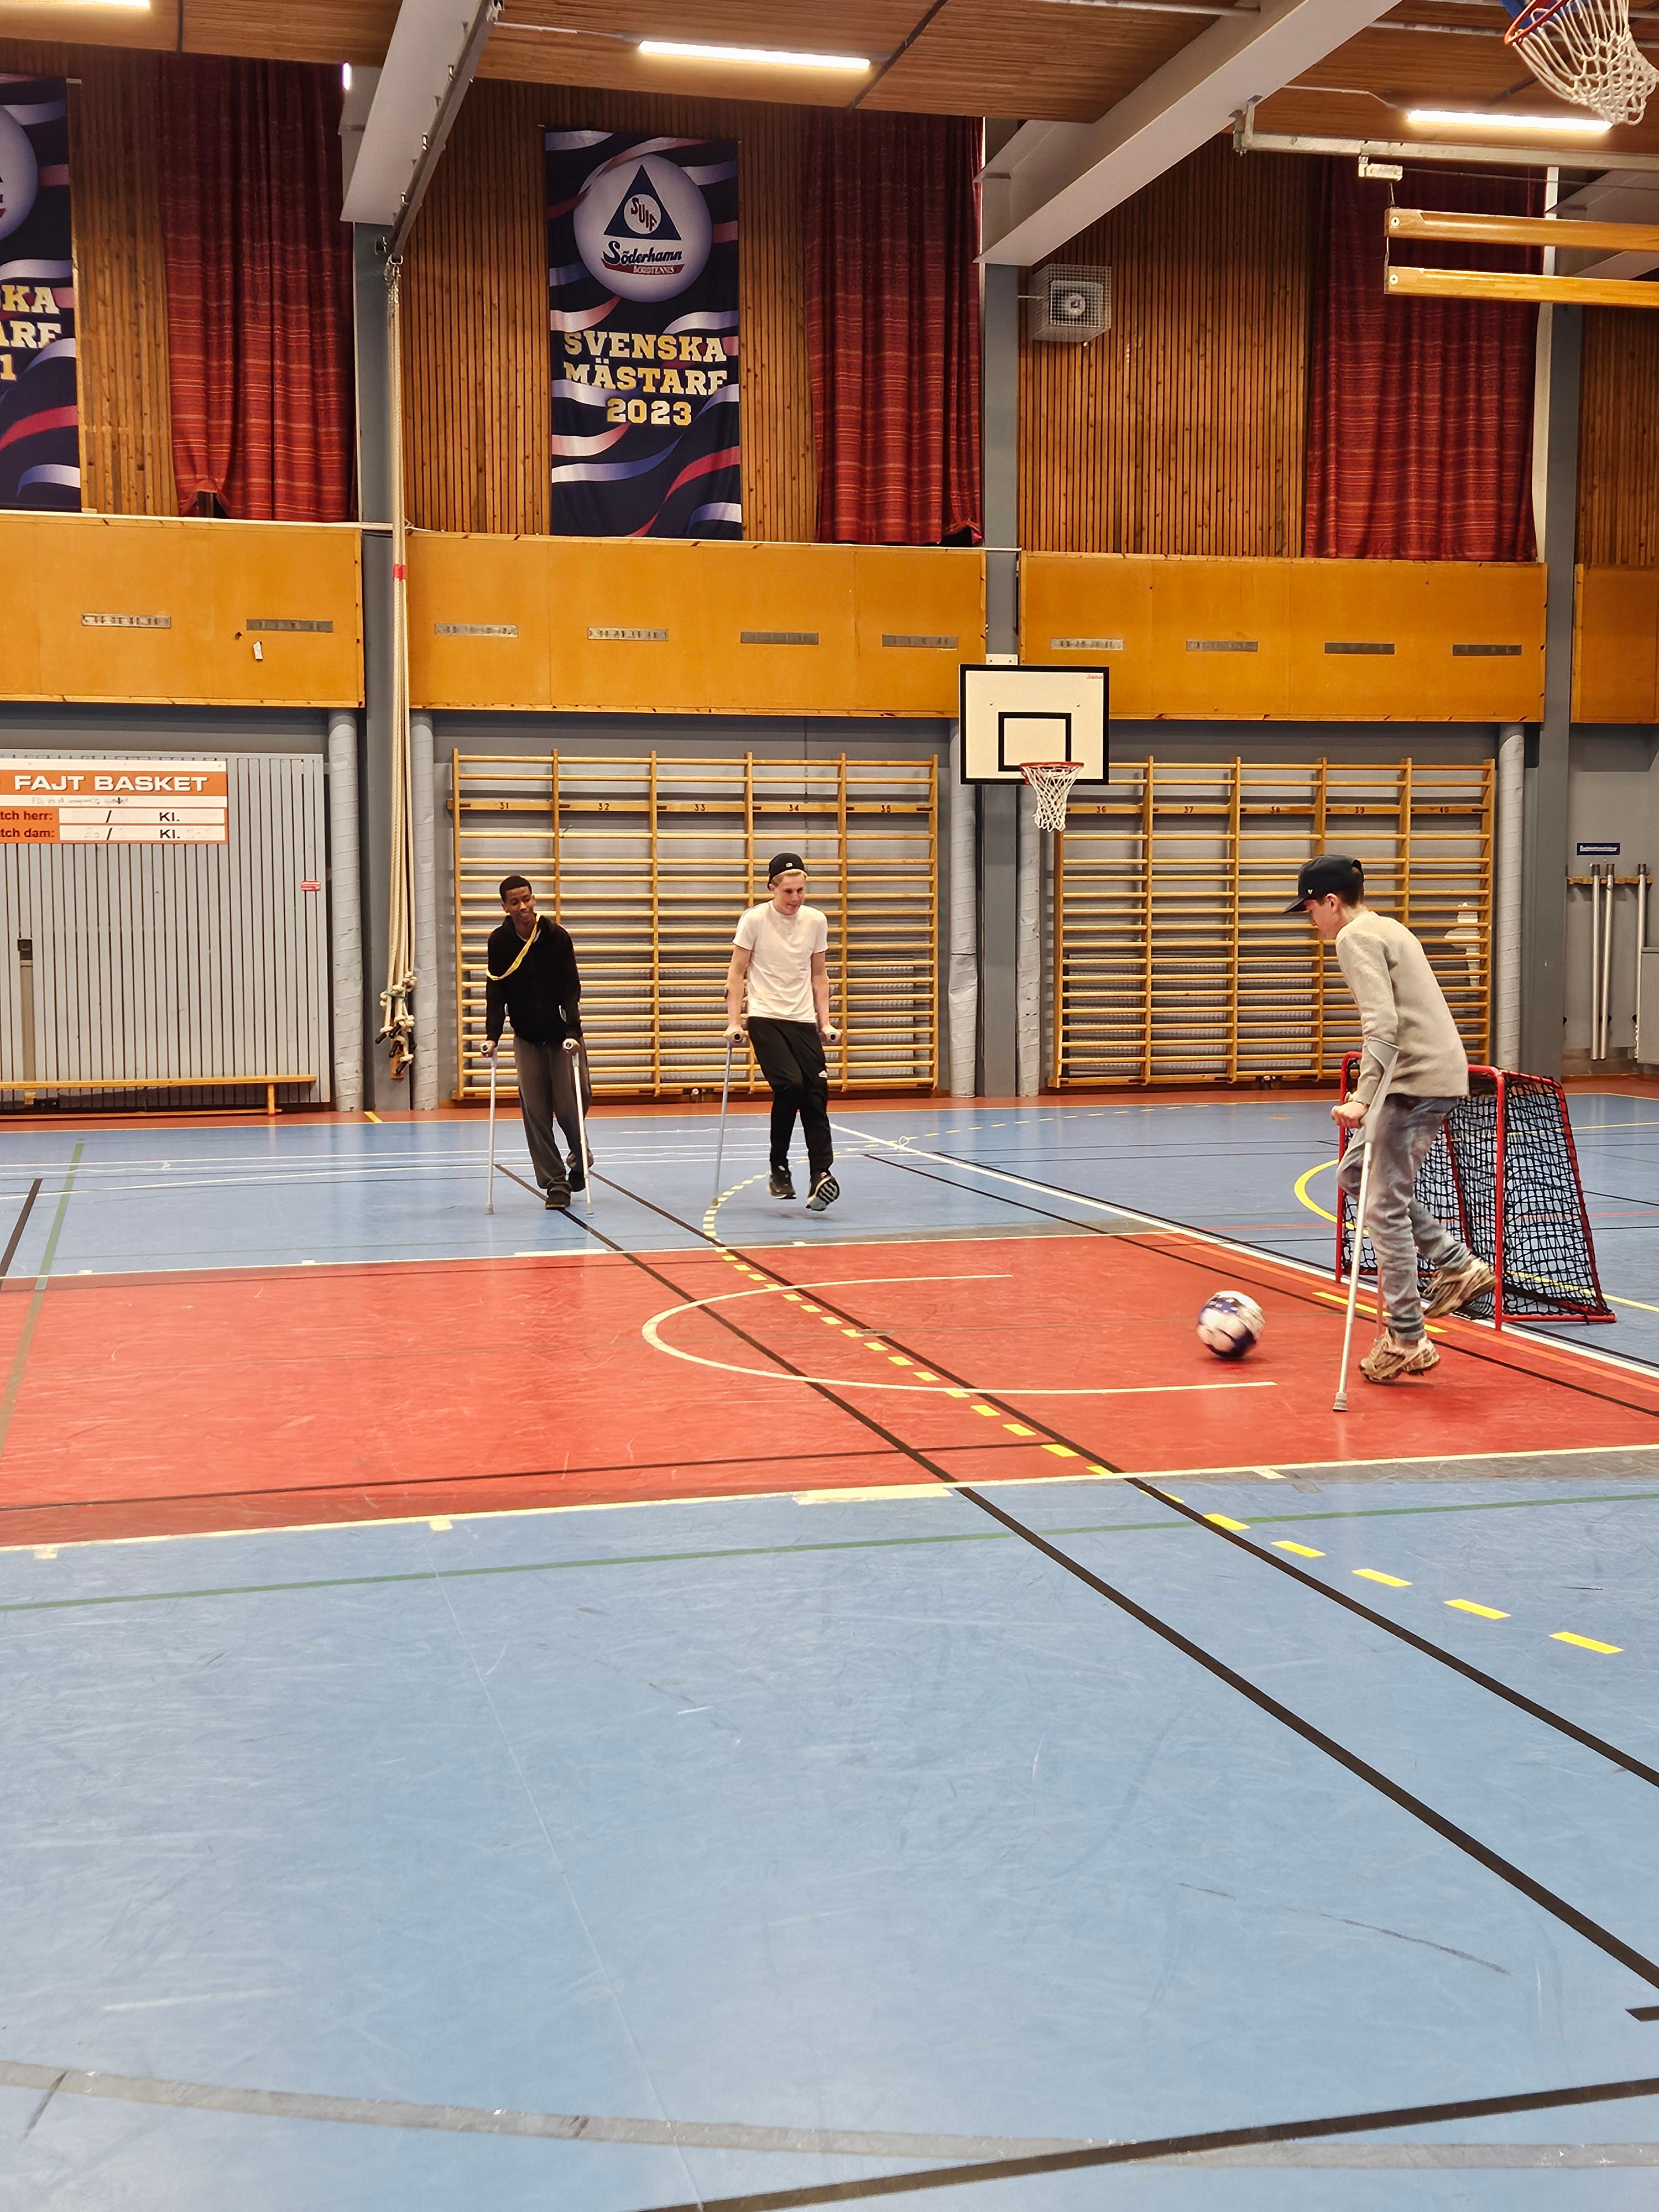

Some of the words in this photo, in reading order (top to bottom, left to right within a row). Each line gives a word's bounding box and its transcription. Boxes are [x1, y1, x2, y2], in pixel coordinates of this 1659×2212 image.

[630, 197, 657, 232] SUIF
[602, 241, 682, 264] Söderhamn
[564, 331, 727, 362] SVENSKA
[607, 398, 691, 426] 2023
[14, 775, 85, 791] FAJT
[95, 776, 208, 791] BASKET
[24, 811, 53, 820] herr:
[24, 828, 55, 837] dam:
